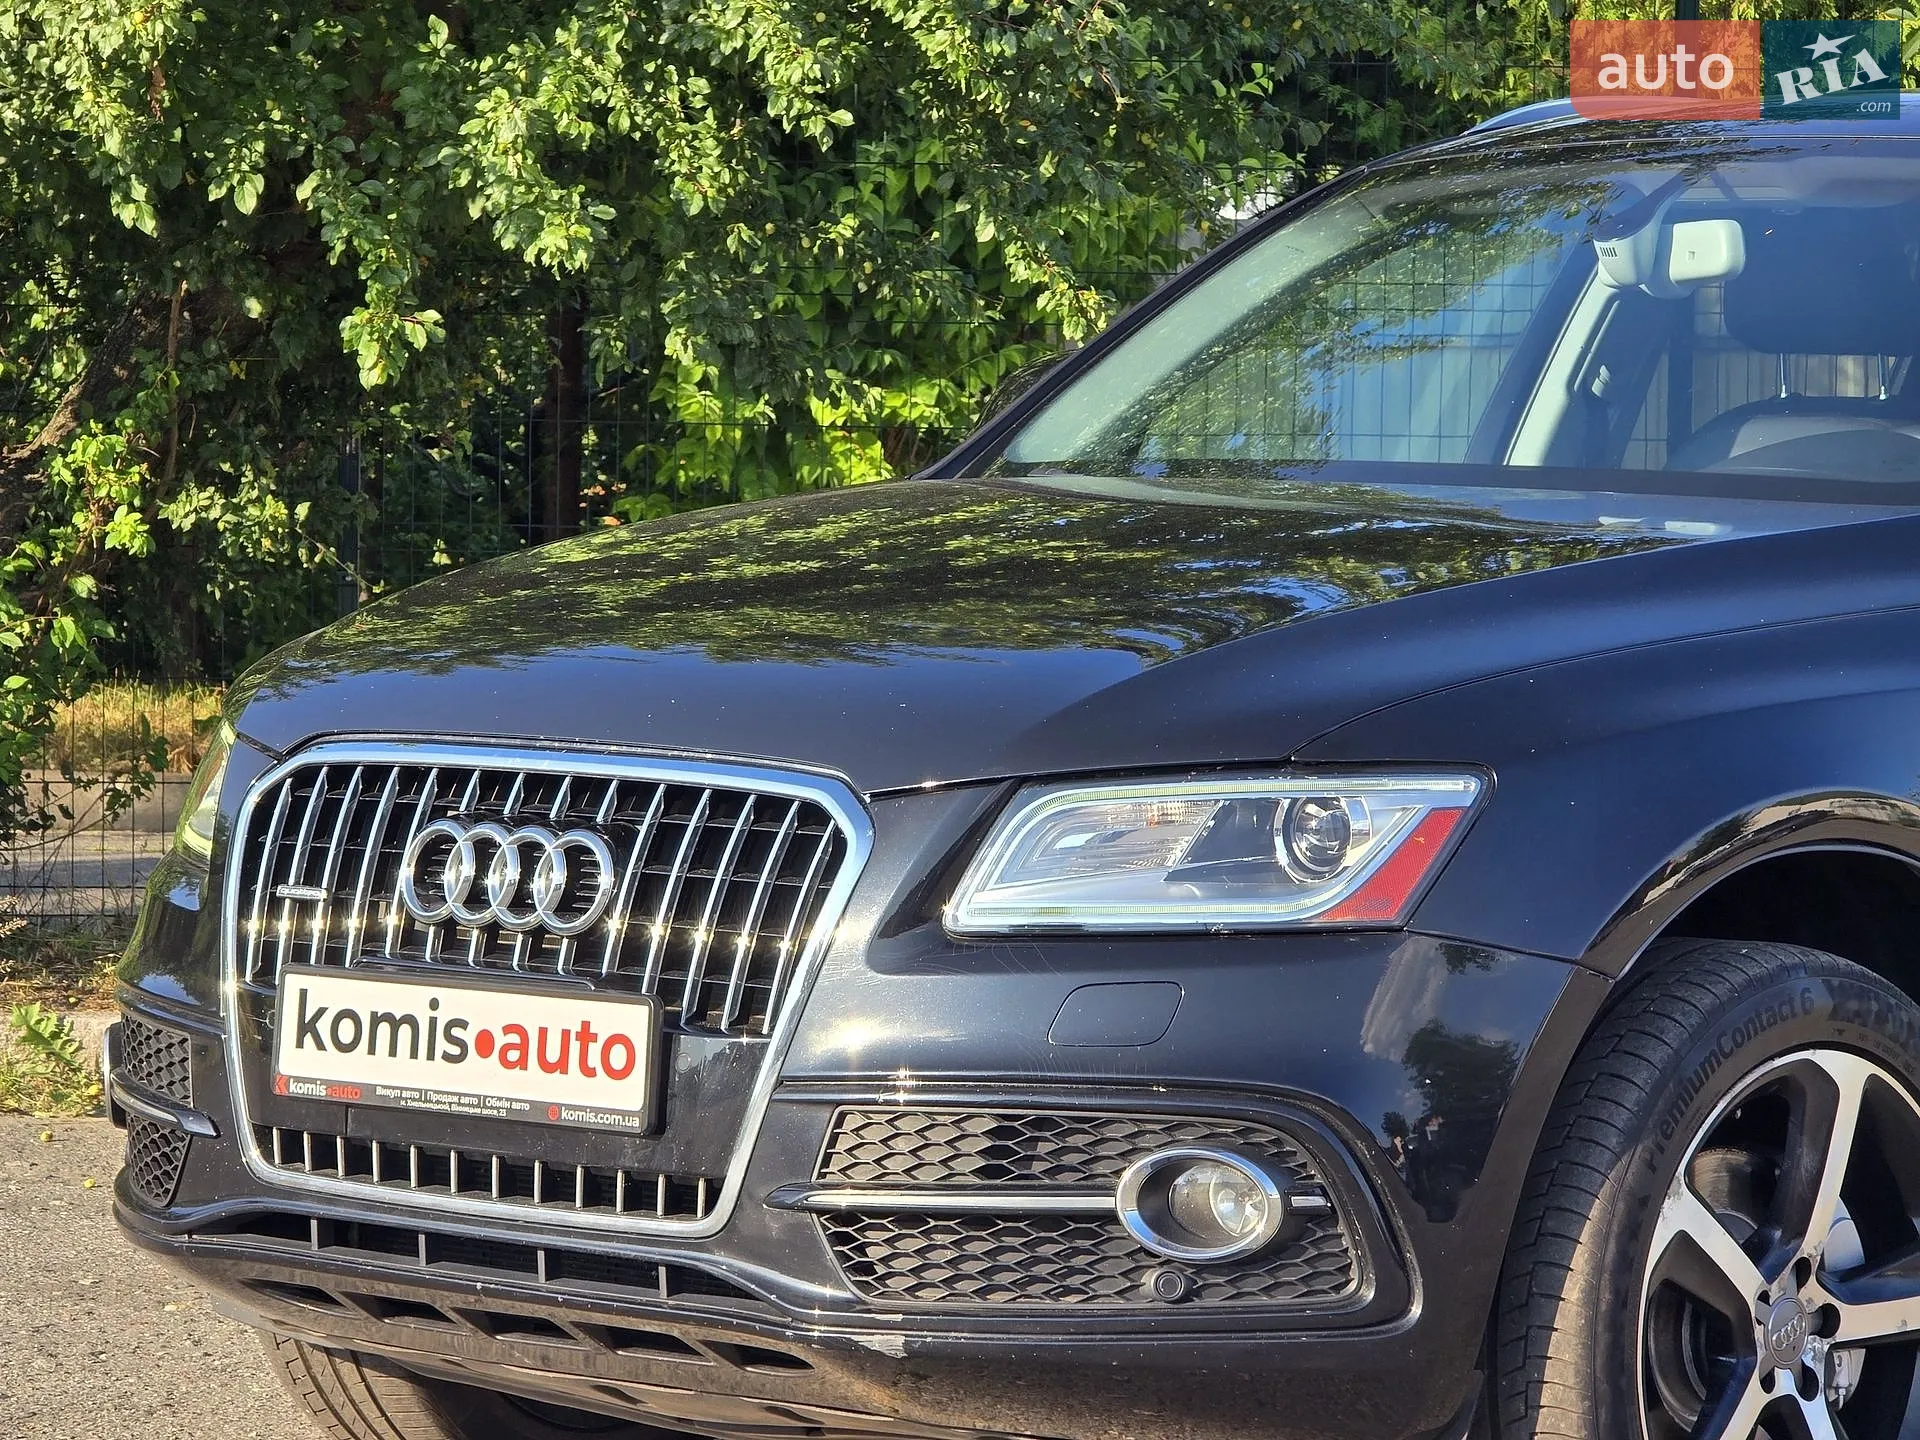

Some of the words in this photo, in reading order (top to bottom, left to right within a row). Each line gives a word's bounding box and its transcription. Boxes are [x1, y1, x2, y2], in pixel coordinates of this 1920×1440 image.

[376, 1086, 400, 1098] Викуп
[402, 1090, 419, 1099] авто
[427, 1091, 459, 1102] Продаж
[460, 1095, 478, 1105] авто
[486, 1097, 510, 1109] Обмін
[511, 1101, 530, 1111] авто
[561, 1106, 640, 1127] komis.com.ua
